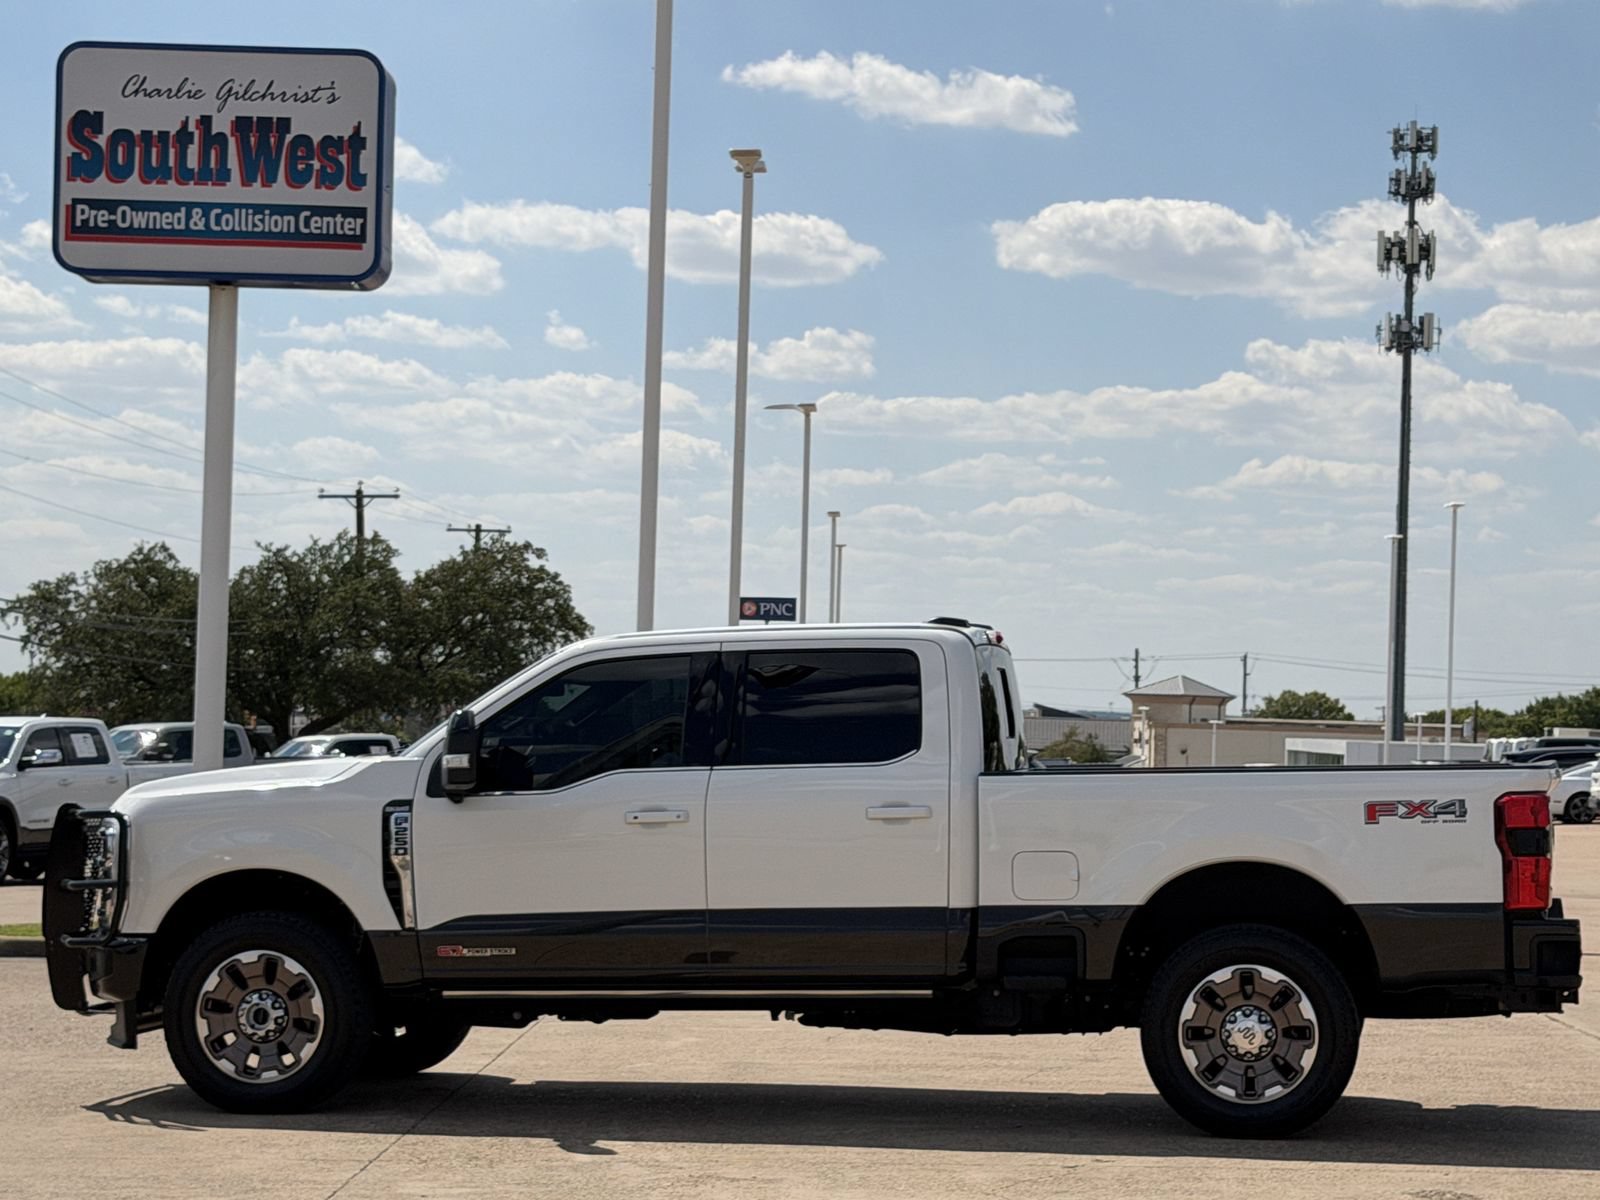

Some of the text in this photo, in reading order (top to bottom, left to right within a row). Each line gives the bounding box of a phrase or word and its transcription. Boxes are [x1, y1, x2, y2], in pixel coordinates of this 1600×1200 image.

[121, 74, 341, 113] Charlie Gilchrist's
[66, 109, 367, 191] SouthWest
[75, 204, 364, 236] Pre-Owned & Collision Center
[759, 602, 793, 617] PNC
[1364, 799, 1467, 825] FX4
